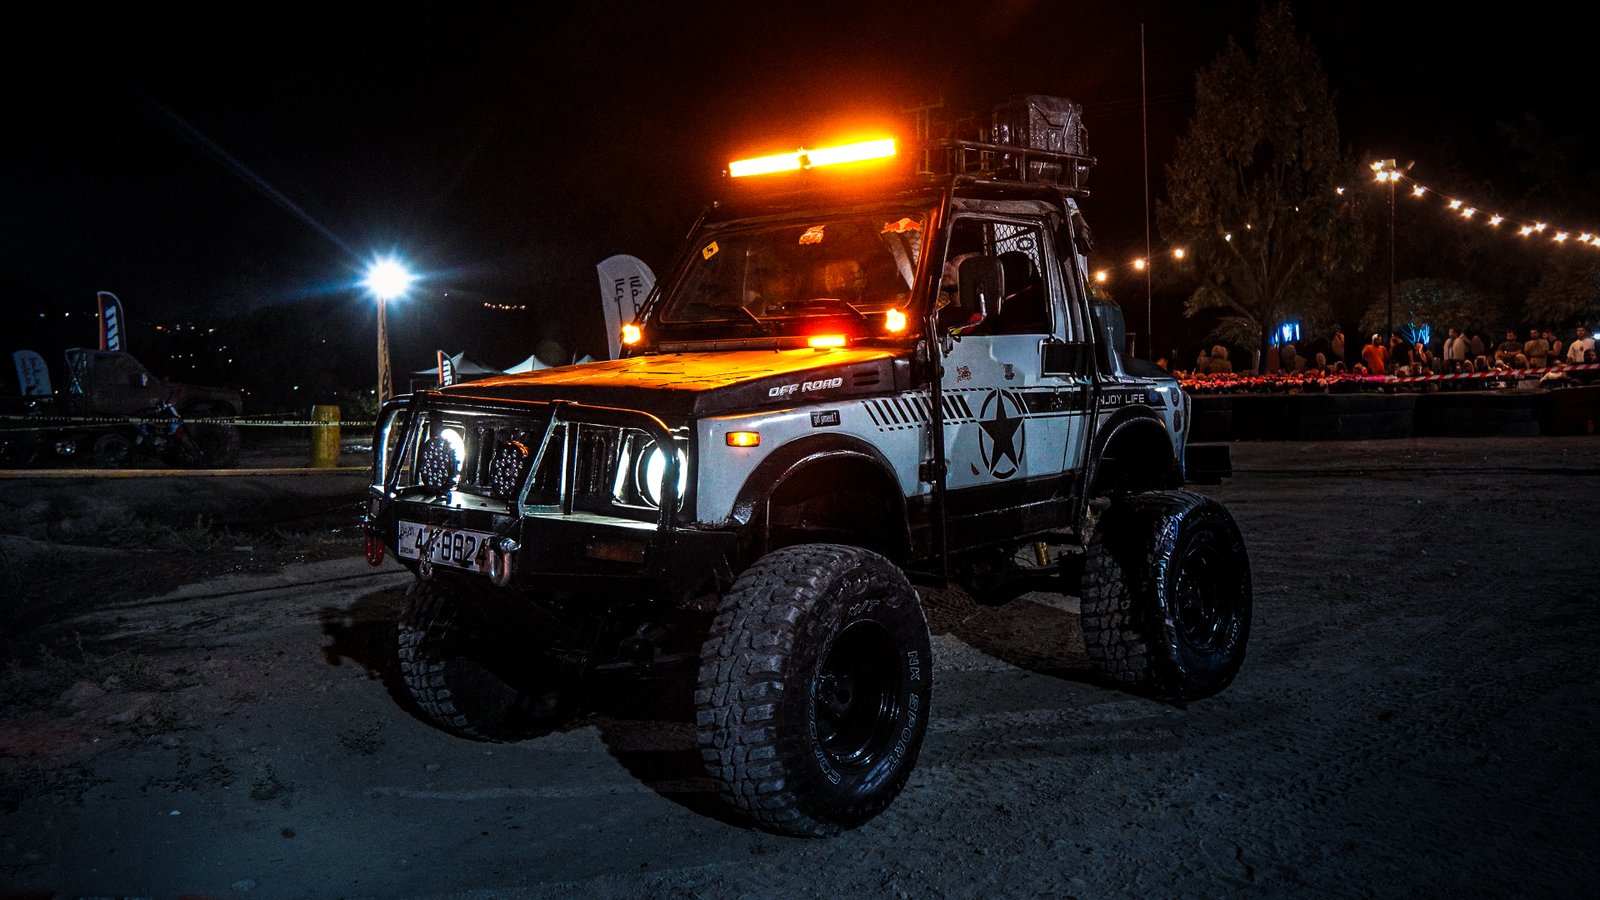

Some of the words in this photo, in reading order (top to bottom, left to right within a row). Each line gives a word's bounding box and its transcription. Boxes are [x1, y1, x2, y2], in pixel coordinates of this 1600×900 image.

[768, 383, 800, 397] OFF
[801, 377, 843, 393] ROAD
[1100, 394, 1122, 405] NJOY
[1125, 393, 1145, 404] LIFE
[908, 650, 921, 681] NK
[887, 692, 920, 772] SPORT
